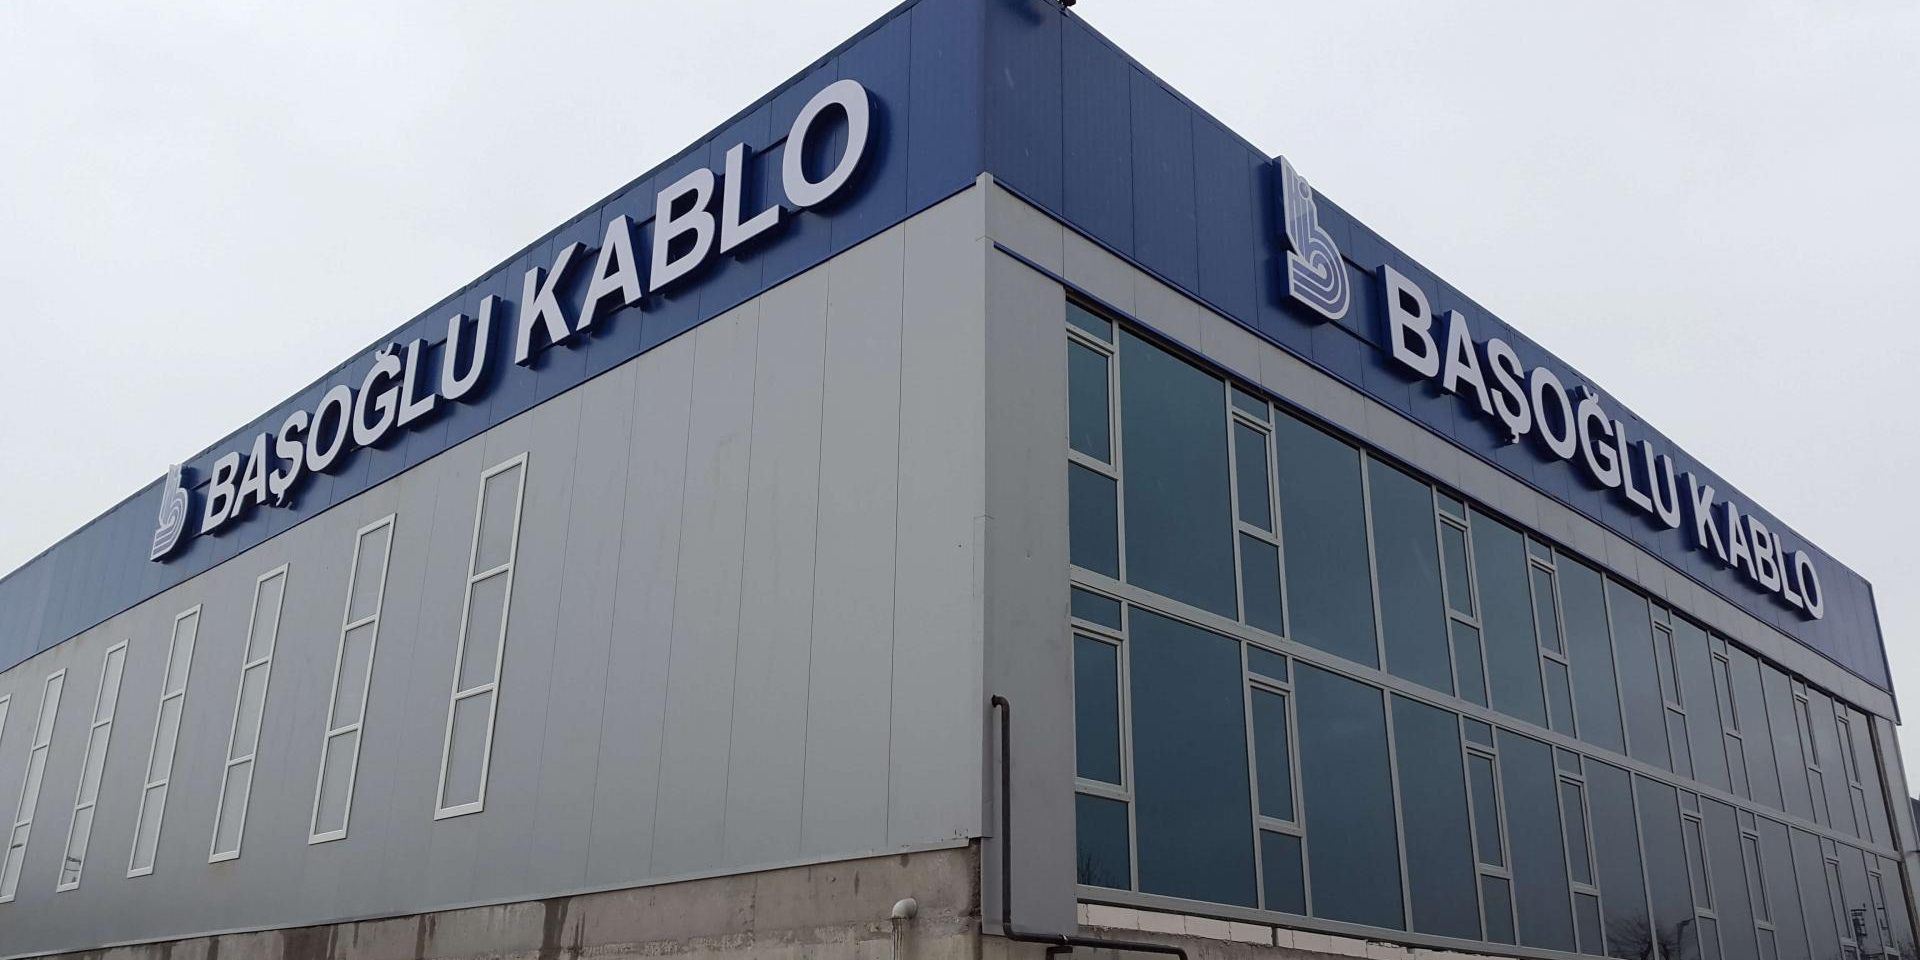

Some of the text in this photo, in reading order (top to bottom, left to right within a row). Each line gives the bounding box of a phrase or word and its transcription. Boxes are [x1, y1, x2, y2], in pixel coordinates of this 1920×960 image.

[201, 294, 500, 535] BAŞOĞLU
[514, 79, 872, 366] KABLO
[1383, 264, 1681, 530] BAŞOĞLU
[1687, 472, 1825, 620] KABLO
